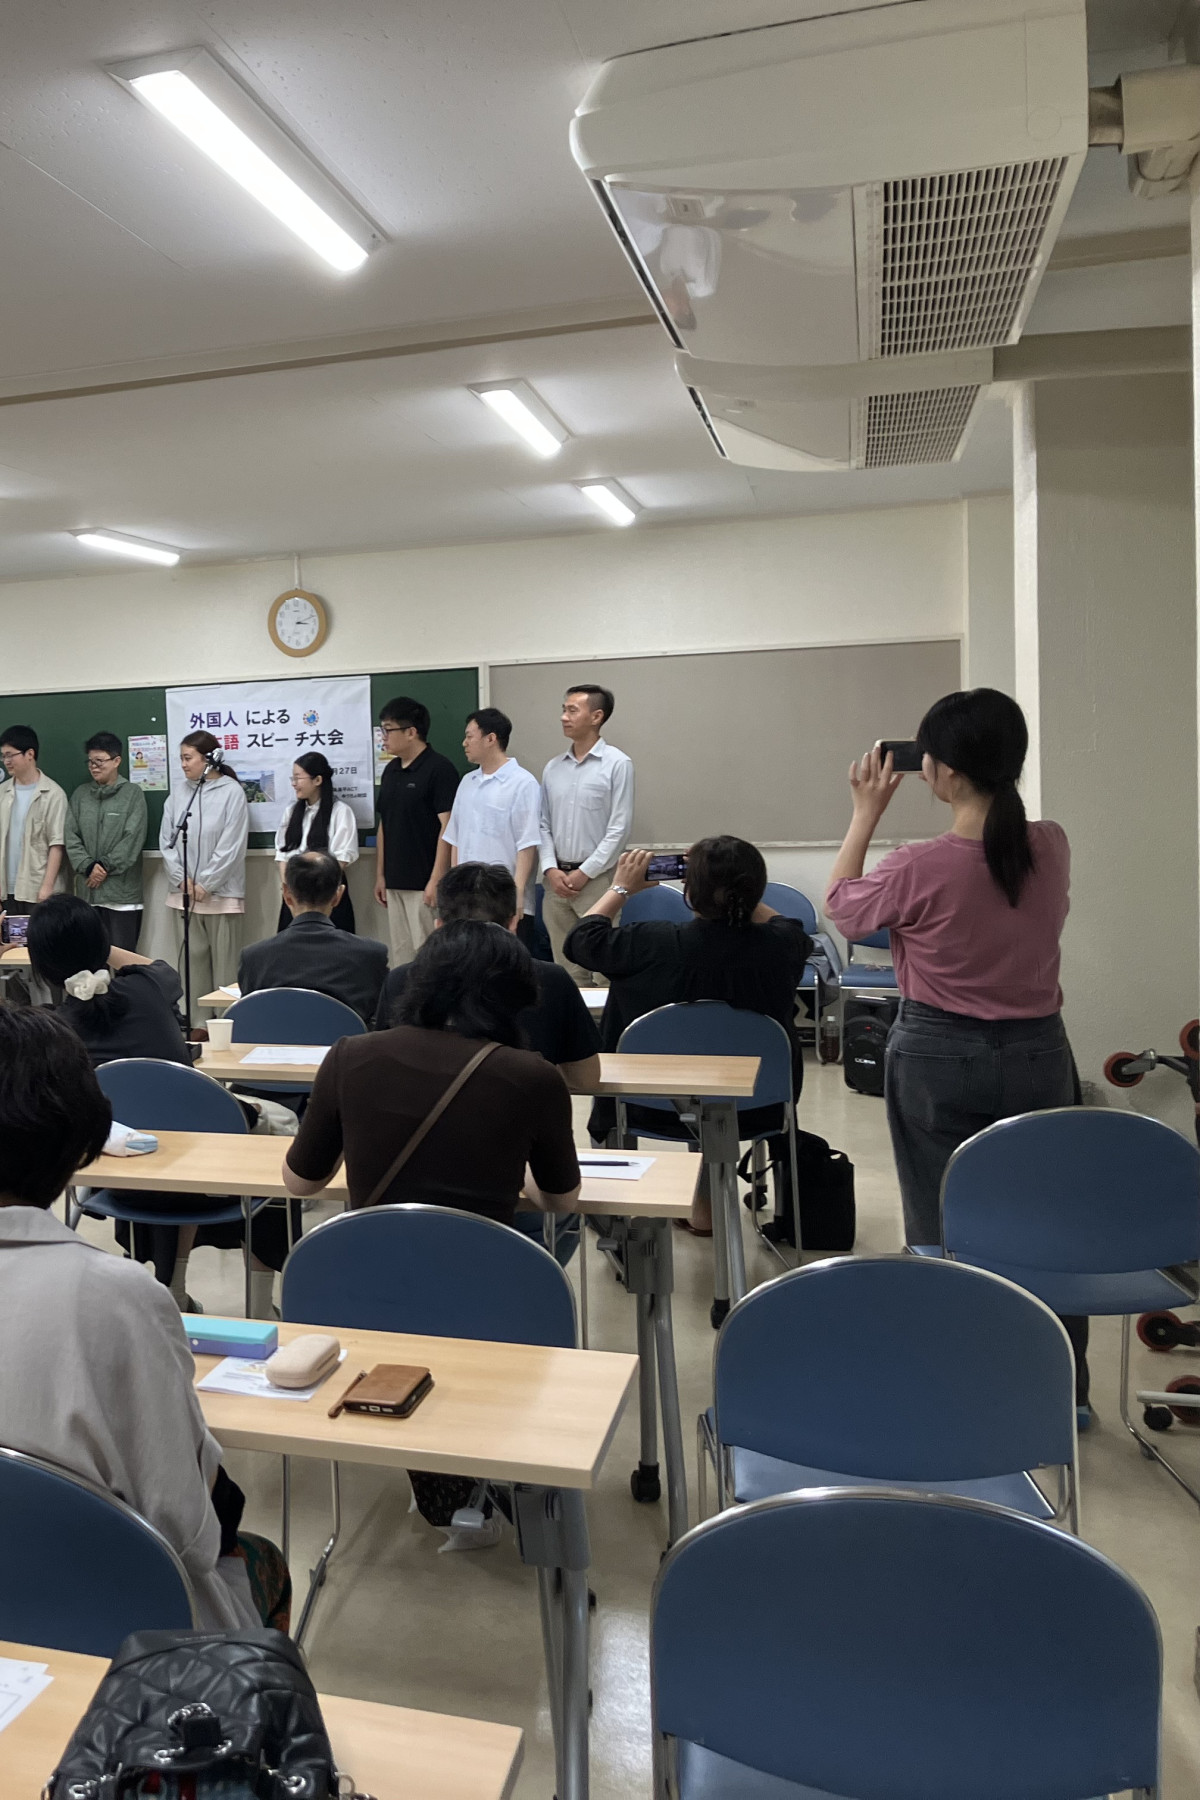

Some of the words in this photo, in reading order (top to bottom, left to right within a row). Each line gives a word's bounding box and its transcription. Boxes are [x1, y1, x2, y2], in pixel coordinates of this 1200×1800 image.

[190, 711, 238, 728] 外国人
[246, 709, 290, 725] による
[246, 729, 344, 748] スピーチ大会
